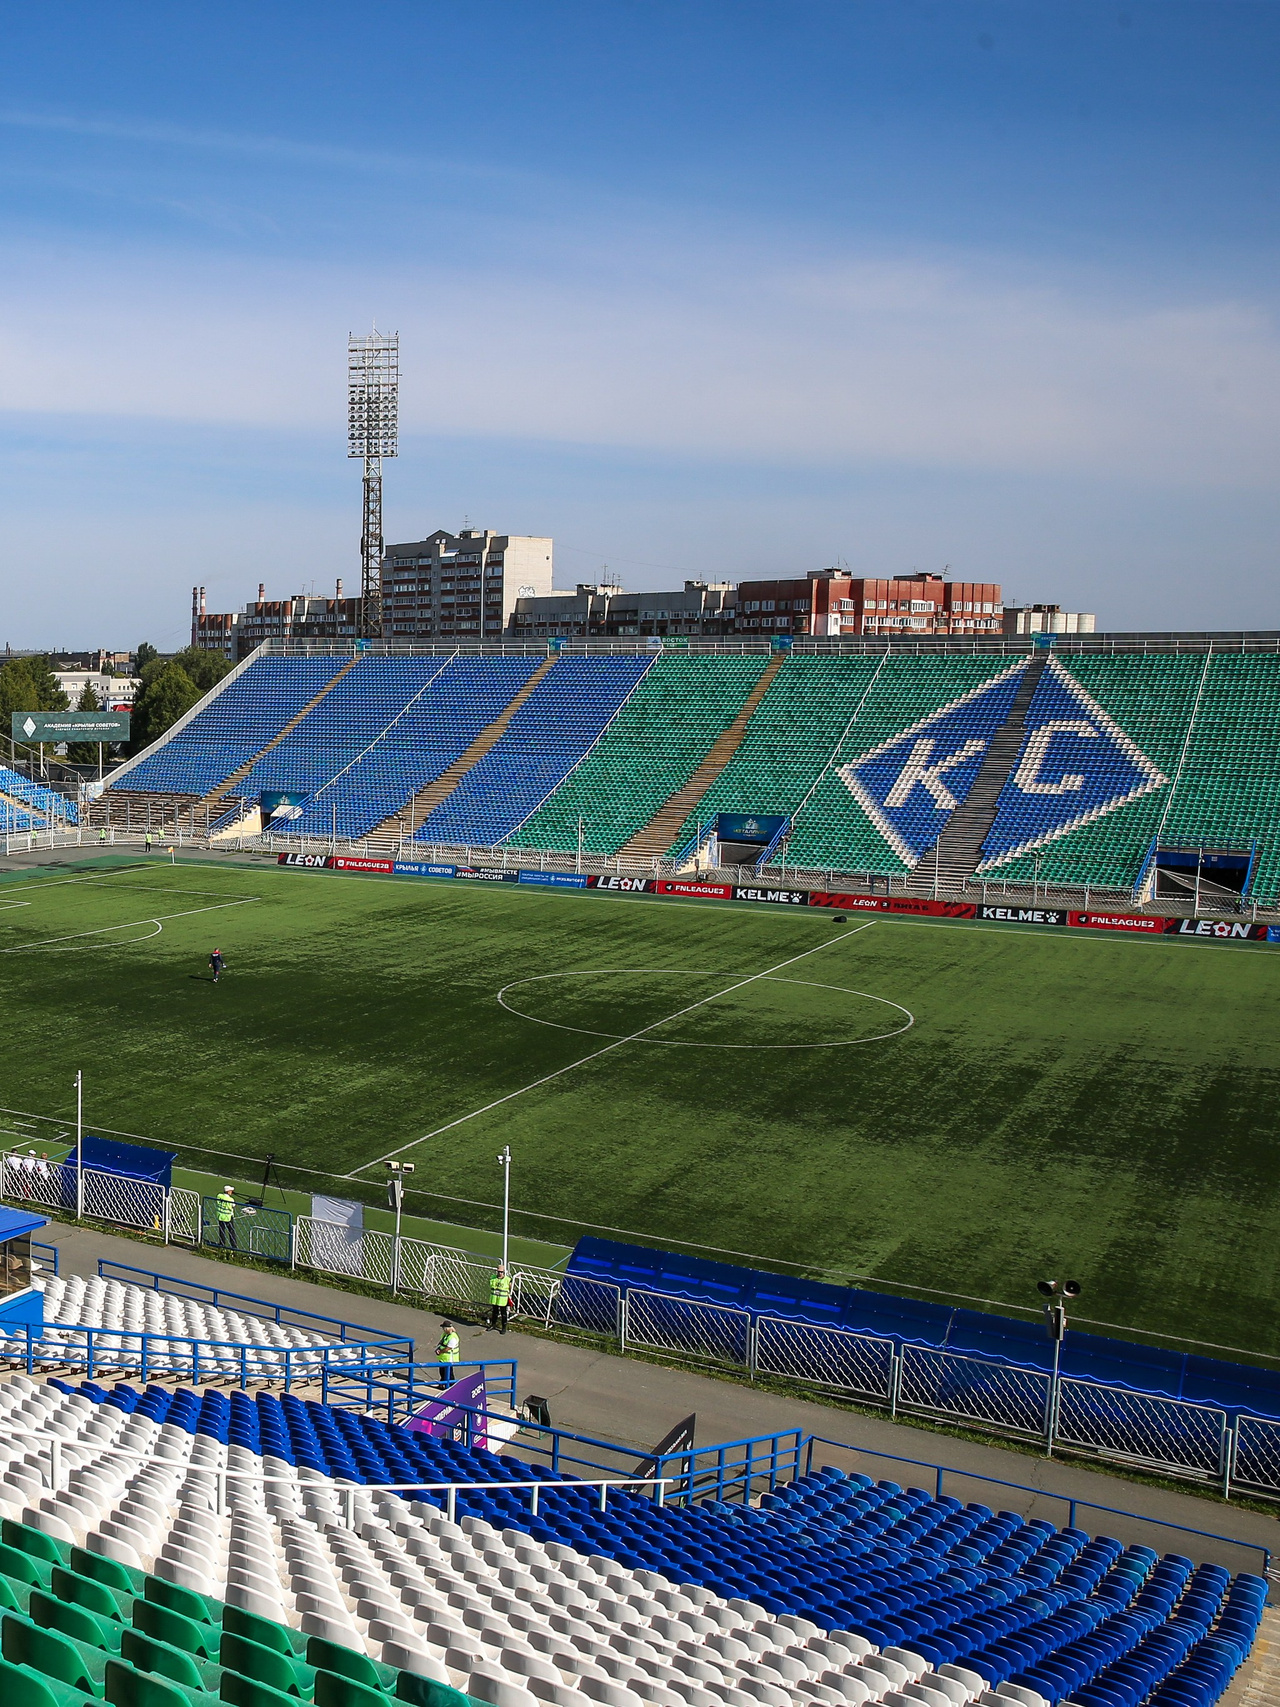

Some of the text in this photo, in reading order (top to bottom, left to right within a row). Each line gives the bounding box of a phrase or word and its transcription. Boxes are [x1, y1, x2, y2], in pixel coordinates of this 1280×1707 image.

[286, 853, 326, 867] LEON
[345, 860, 389, 869] FNLEAGUE2B
[395, 864, 453, 874] КРЫЛЬЯ СОВЕТОВ
[456, 871, 503, 880] #МЫРОССИЯ
[597, 875, 646, 891] LEON
[675, 884, 724, 895] FNLEAGUE2
[736, 888, 789, 902] KELME
[853, 898, 878, 907] LEON
[982, 907, 1045, 923] KELME
[1091, 916, 1155, 928] FNLEAGUE2
[1179, 919, 1252, 938] LEON
[471, 1382, 484, 1399] 2024
